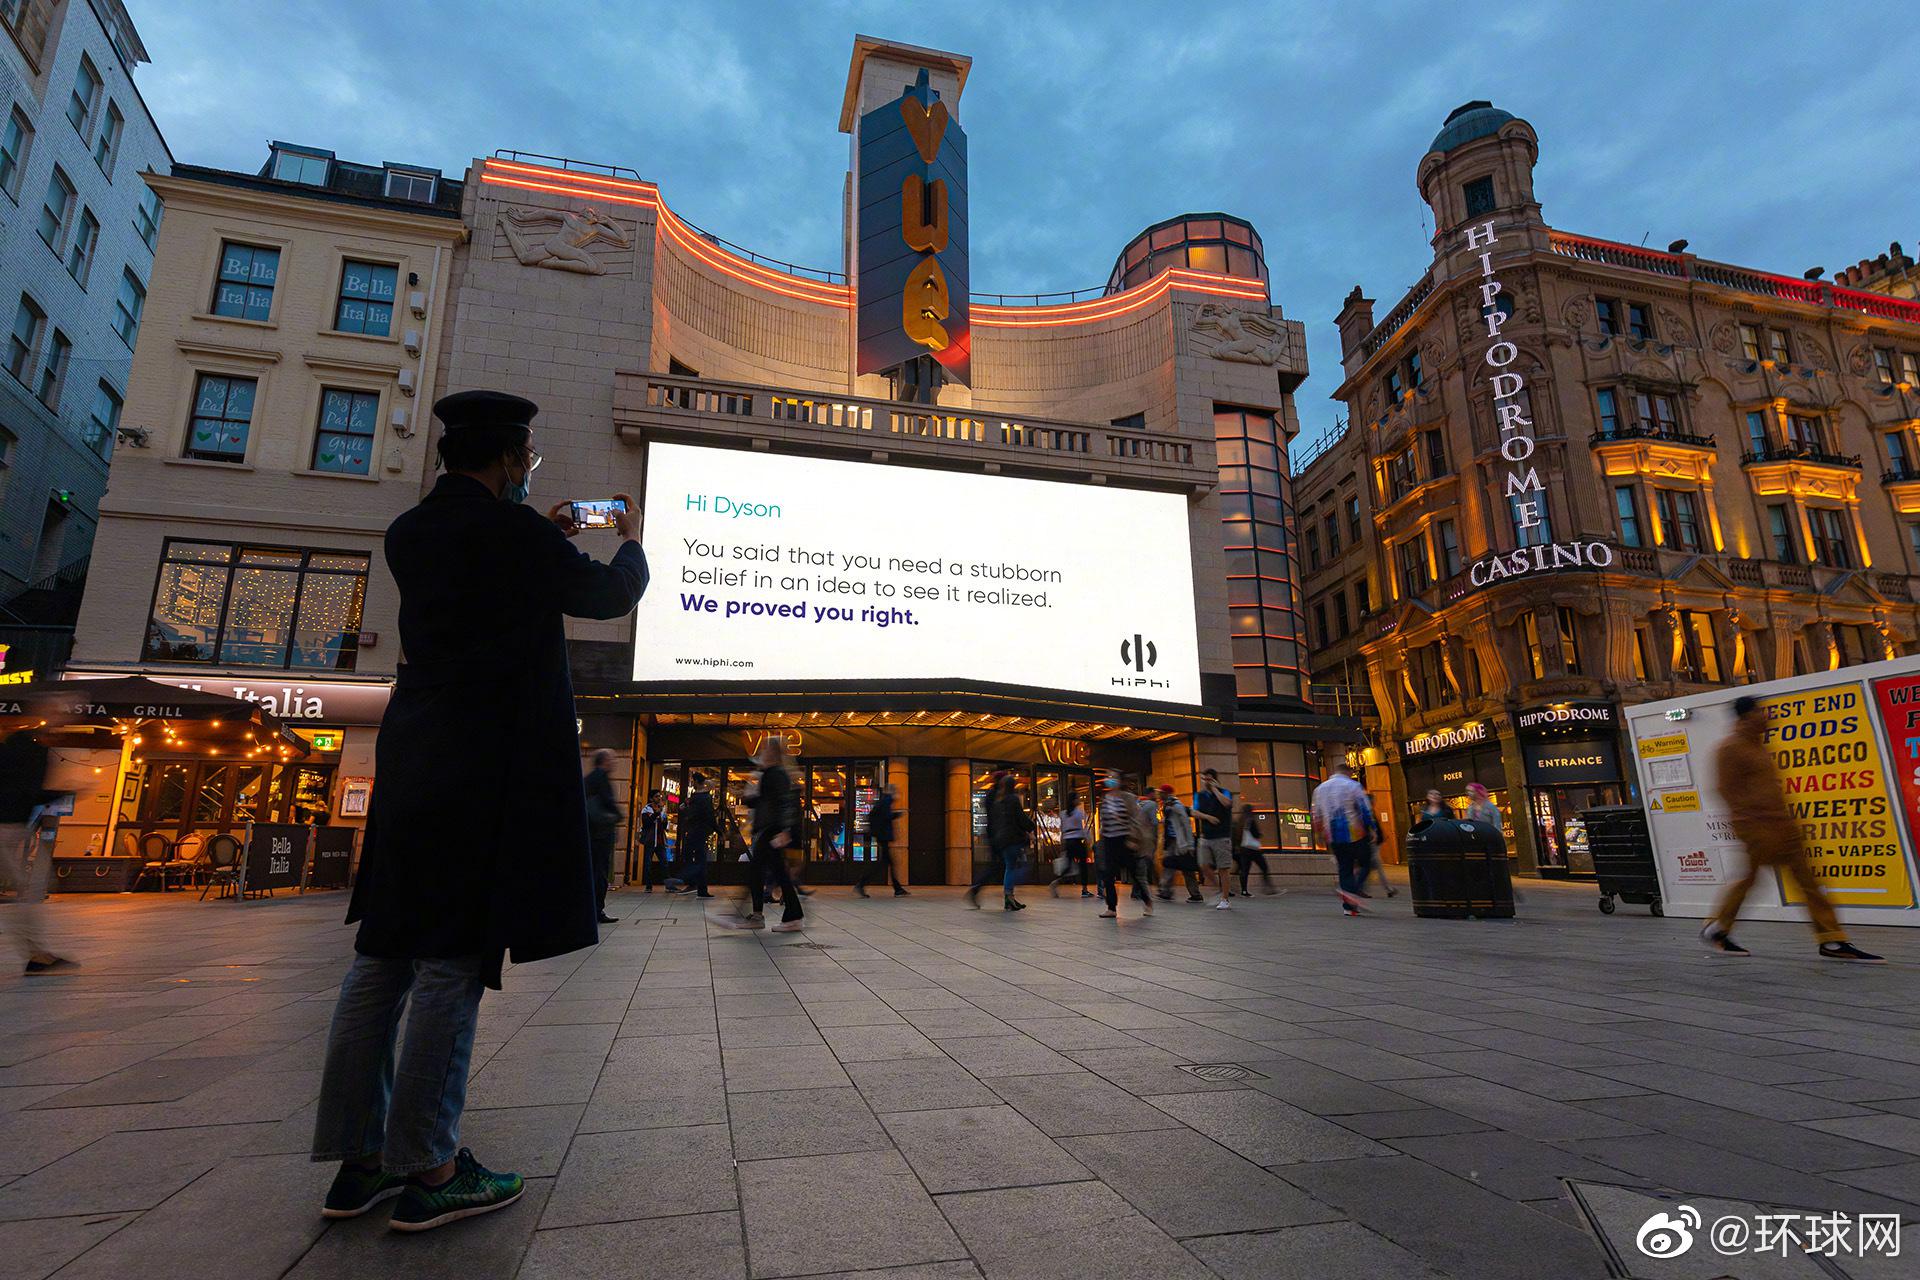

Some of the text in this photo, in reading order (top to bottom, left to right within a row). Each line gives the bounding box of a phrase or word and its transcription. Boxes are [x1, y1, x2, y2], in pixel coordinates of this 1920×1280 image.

[223, 258, 275, 280] Bella
[345, 275, 393, 296] Bella
[219, 288, 270, 308] Italia
[341, 304, 389, 323] Italia
[1464, 220, 1546, 529] HIPPODROME
[686, 494, 781, 518] Hi Dyson
[684, 537, 1062, 583] You said that you need a stubborn
[1470, 541, 1613, 587] CASINO
[681, 565, 1053, 608] belief in an idea to see it realized.
[680, 592, 919, 628] We proved you right.
[675, 657, 754, 669] www.hiphi.com
[61, 704, 108, 715] ASTA
[133, 705, 183, 717] GRILL
[1814, 693, 1856, 714] END
[1518, 707, 1610, 728] HIPPODROME
[1405, 723, 1486, 755] HIPPODROME
[1763, 716, 1859, 744] FOODS
[1654, 738, 1686, 748] Warning
[1538, 756, 1603, 768] ENTRANCE
[1773, 741, 1868, 771] OBACCO
[1443, 771, 1463, 781] POKER
[1784, 770, 1875, 795] NACKS
[1665, 795, 1695, 803] Caution
[1787, 797, 1887, 819] WEETS
[1802, 820, 1887, 840] RINKS
[272, 837, 292, 854] Bella
[1838, 844, 1897, 857] VAPES
[269, 856, 290, 874] Italia
